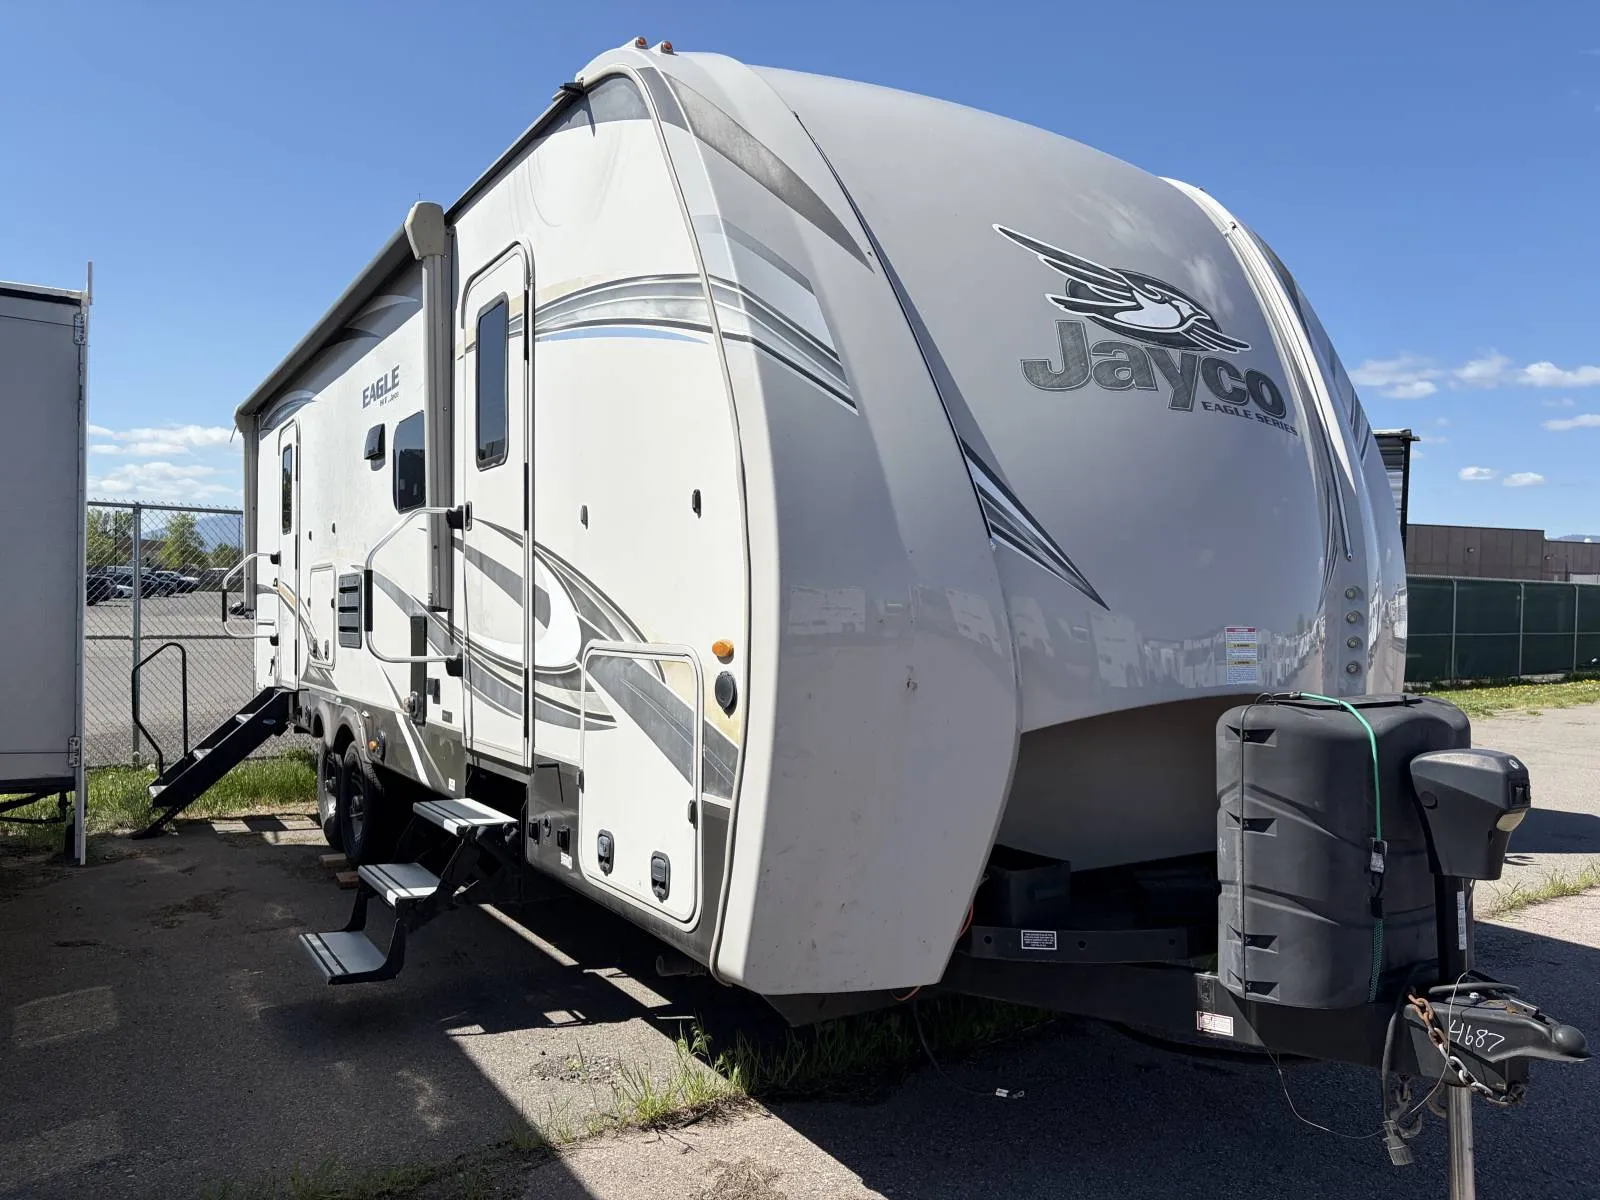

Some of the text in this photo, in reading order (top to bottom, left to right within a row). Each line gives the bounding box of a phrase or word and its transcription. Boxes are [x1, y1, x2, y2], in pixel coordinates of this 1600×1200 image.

[362, 365, 400, 409] EAGLE
[1020, 319, 1287, 419] Jayco
[1202, 401, 1298, 436] EAGLE SERIES
[1449, 1019, 1505, 1053] 4687
